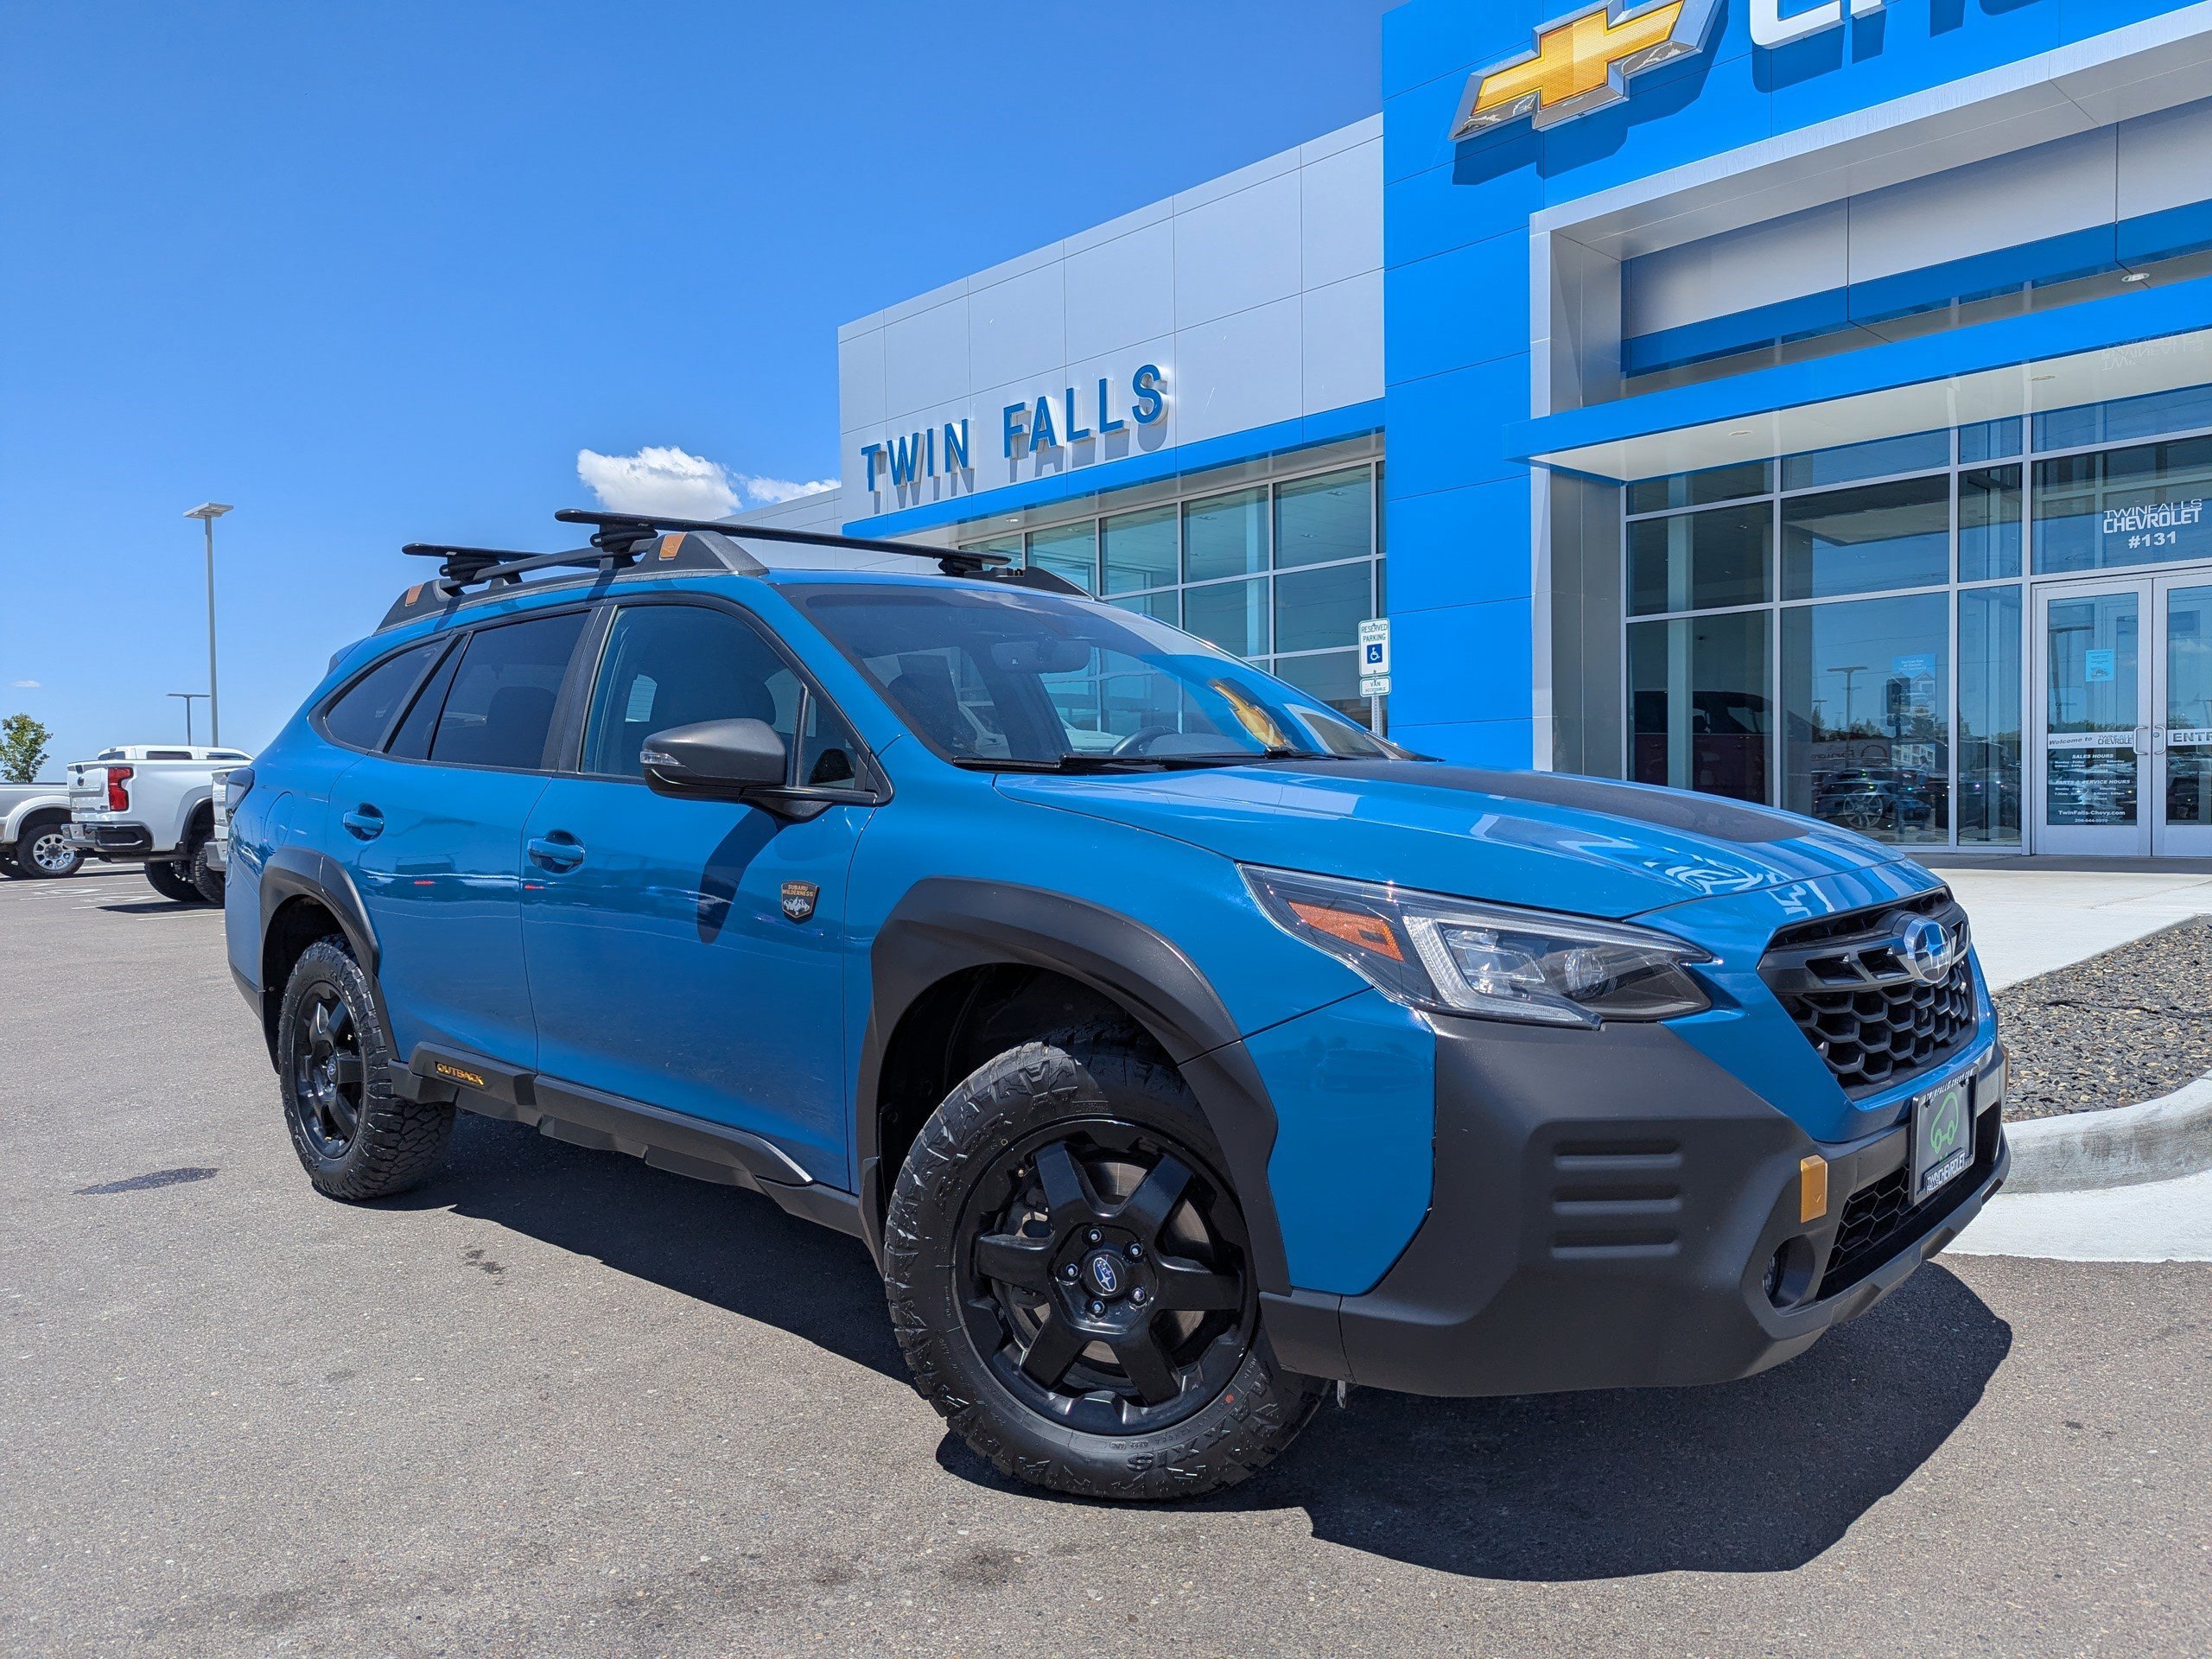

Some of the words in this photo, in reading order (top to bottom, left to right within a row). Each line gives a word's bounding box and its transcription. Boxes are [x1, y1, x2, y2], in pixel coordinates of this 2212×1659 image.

[861, 418, 974, 493] TWIN
[1003, 364, 1167, 459] FALLS
[2103, 498, 2202, 519] TWINFALLS
[2103, 506, 2202, 534] CHEVROLET
[2128, 531, 2176, 550] #131
[1361, 623, 1388, 633] RESERVED
[1363, 632, 1386, 643] PARKING
[436, 1063, 484, 1085] OUTBACK
